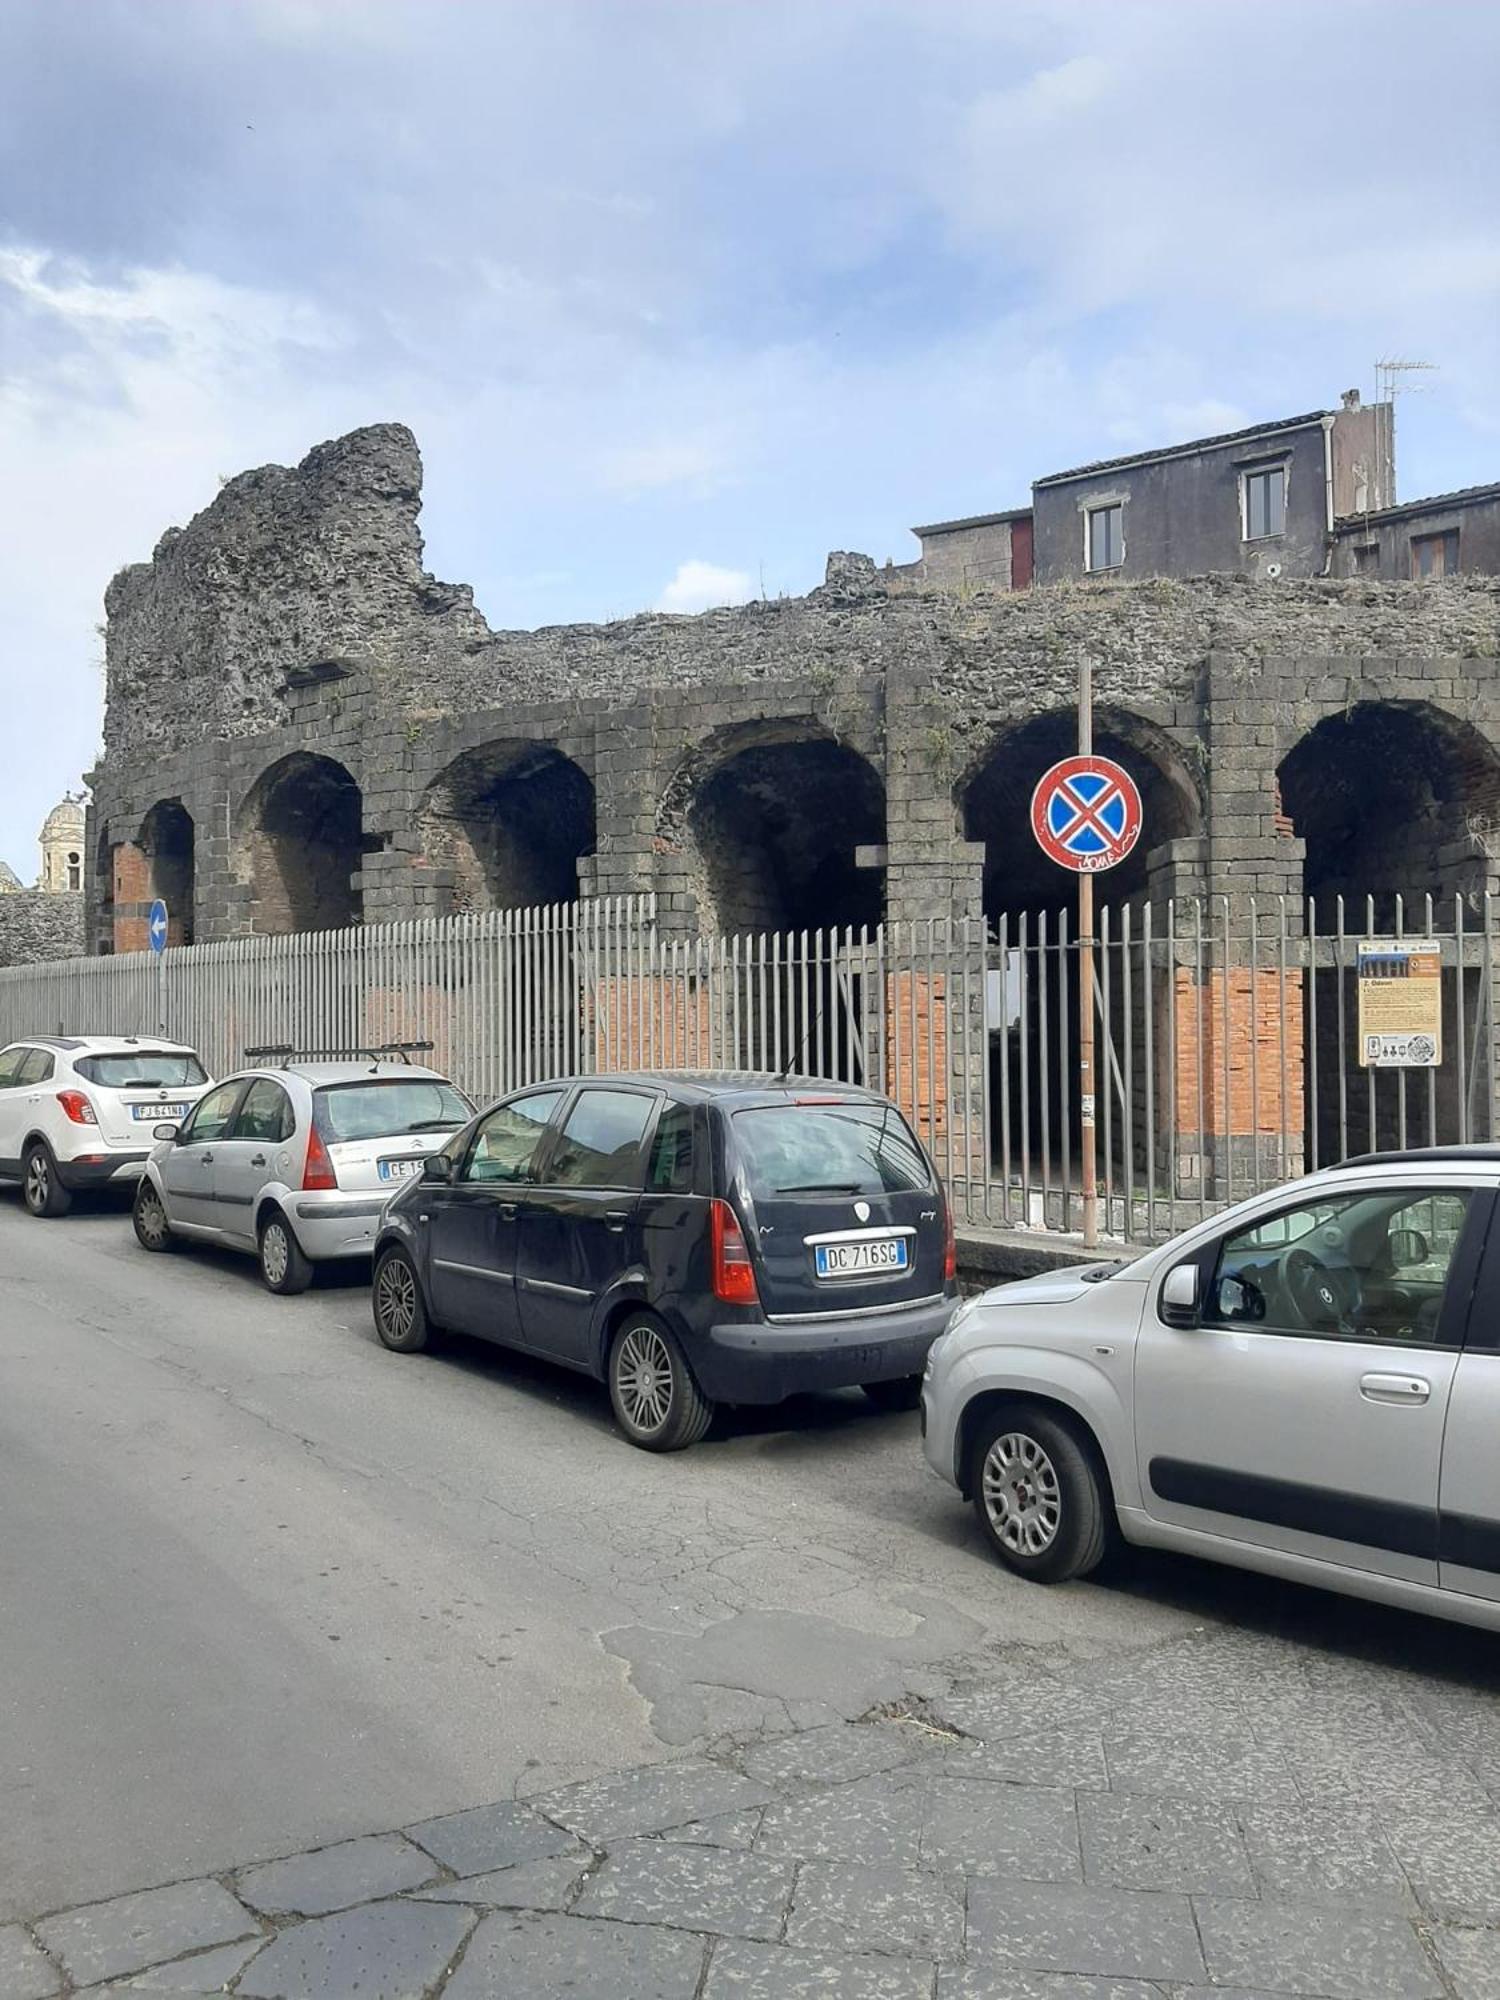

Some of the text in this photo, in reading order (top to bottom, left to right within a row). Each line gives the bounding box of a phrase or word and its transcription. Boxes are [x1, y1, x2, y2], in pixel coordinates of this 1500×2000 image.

[391, 1162, 406, 1176] CE
[828, 1244, 897, 1268] DC 716SG
